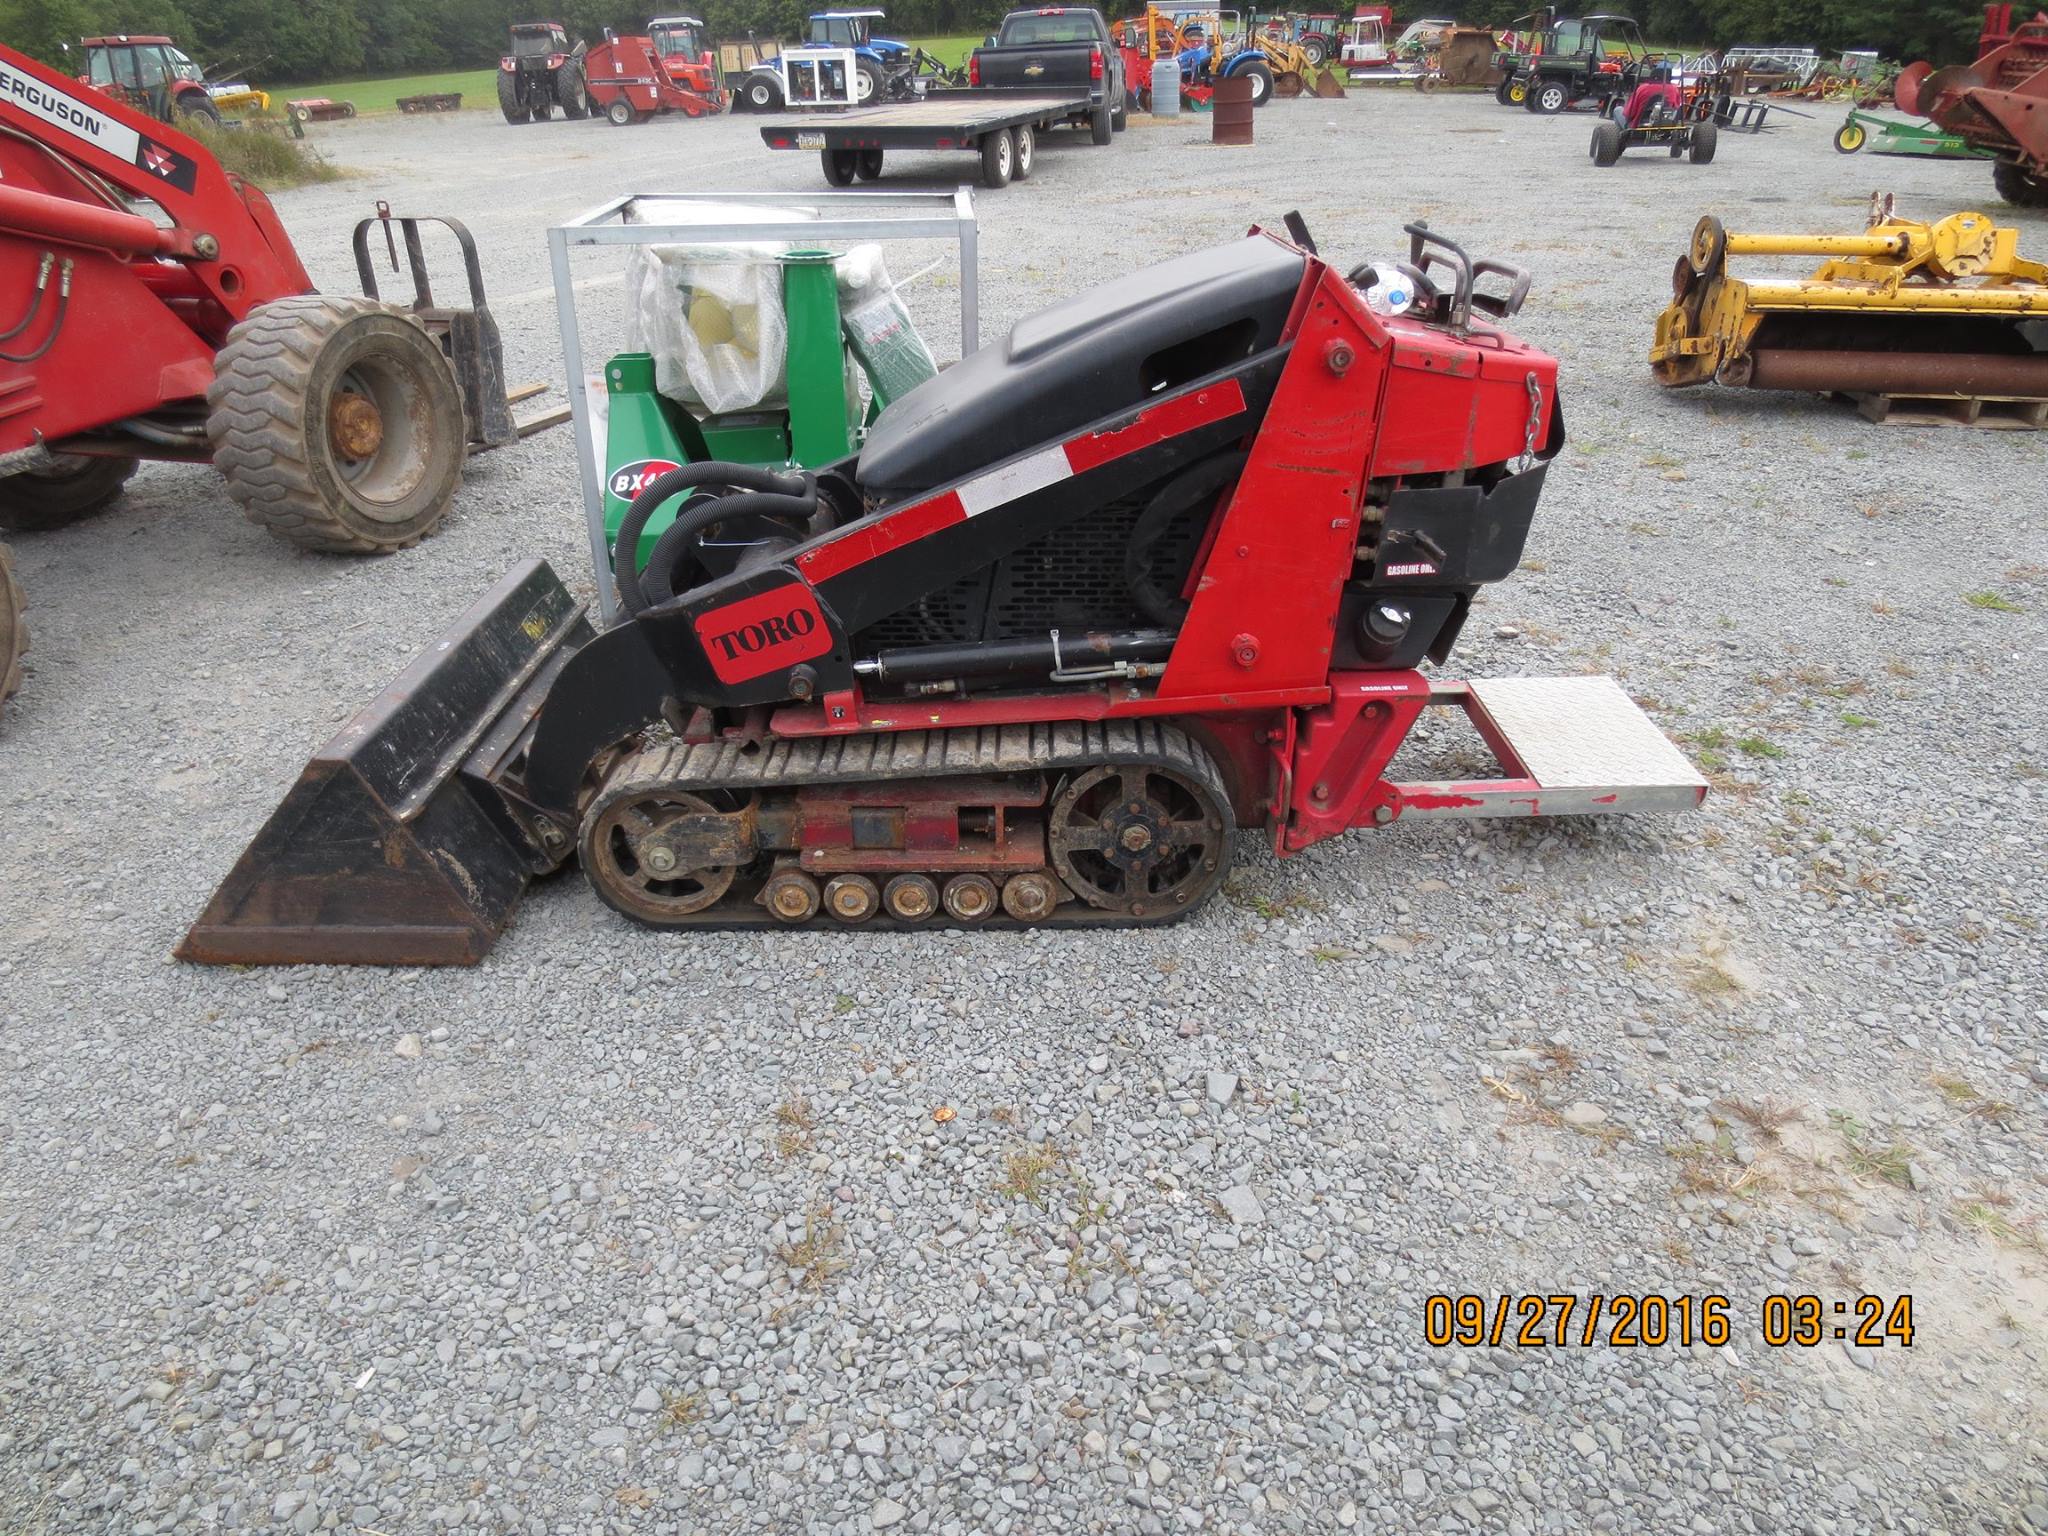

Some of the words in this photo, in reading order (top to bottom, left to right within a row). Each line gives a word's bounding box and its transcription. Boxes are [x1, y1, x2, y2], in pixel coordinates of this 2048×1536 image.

[615, 472, 669, 492] BX4
[1386, 564, 1420, 576] GASOLINE
[711, 608, 815, 660] TORO
